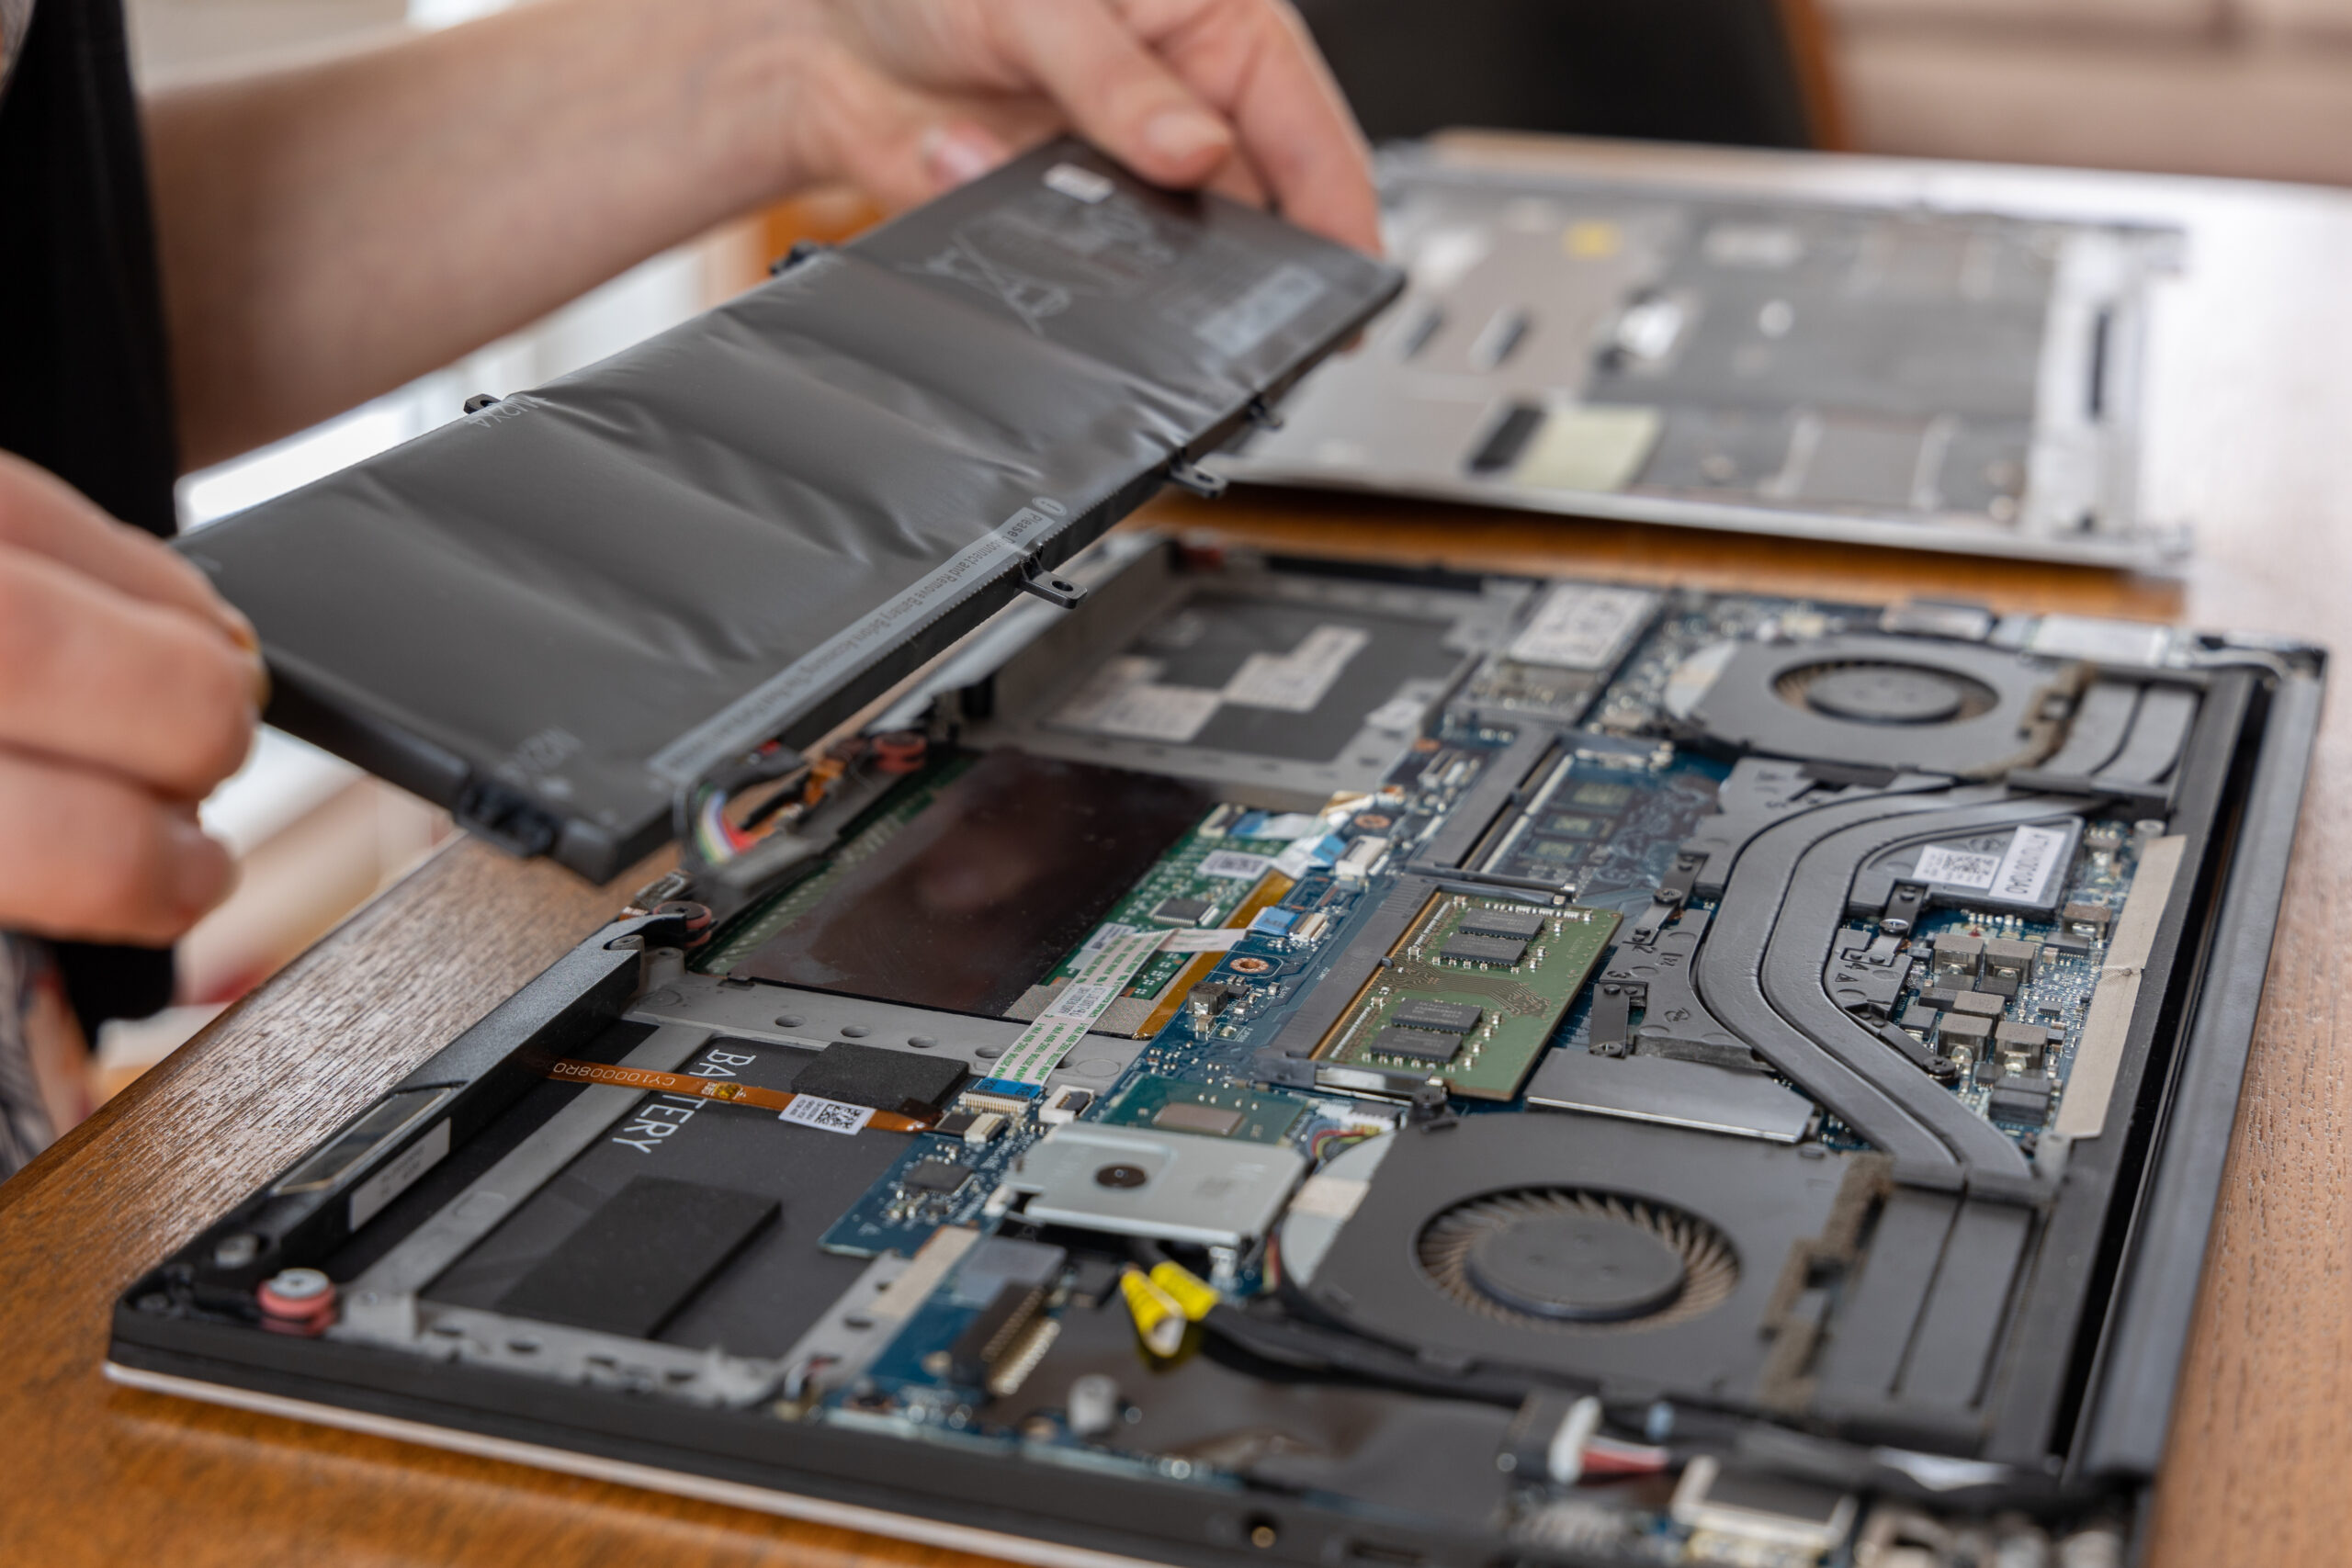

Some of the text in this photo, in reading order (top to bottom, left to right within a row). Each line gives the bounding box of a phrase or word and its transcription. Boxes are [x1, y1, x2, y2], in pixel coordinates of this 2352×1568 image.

[1007, 513, 1043, 537] Please
[948, 561, 970, 578] and
[914, 573, 957, 600] Remove
[879, 596, 924, 622] Battery
[992, 1067, 1007, 1079] WM
[612, 1049, 757, 1154] BATERY
